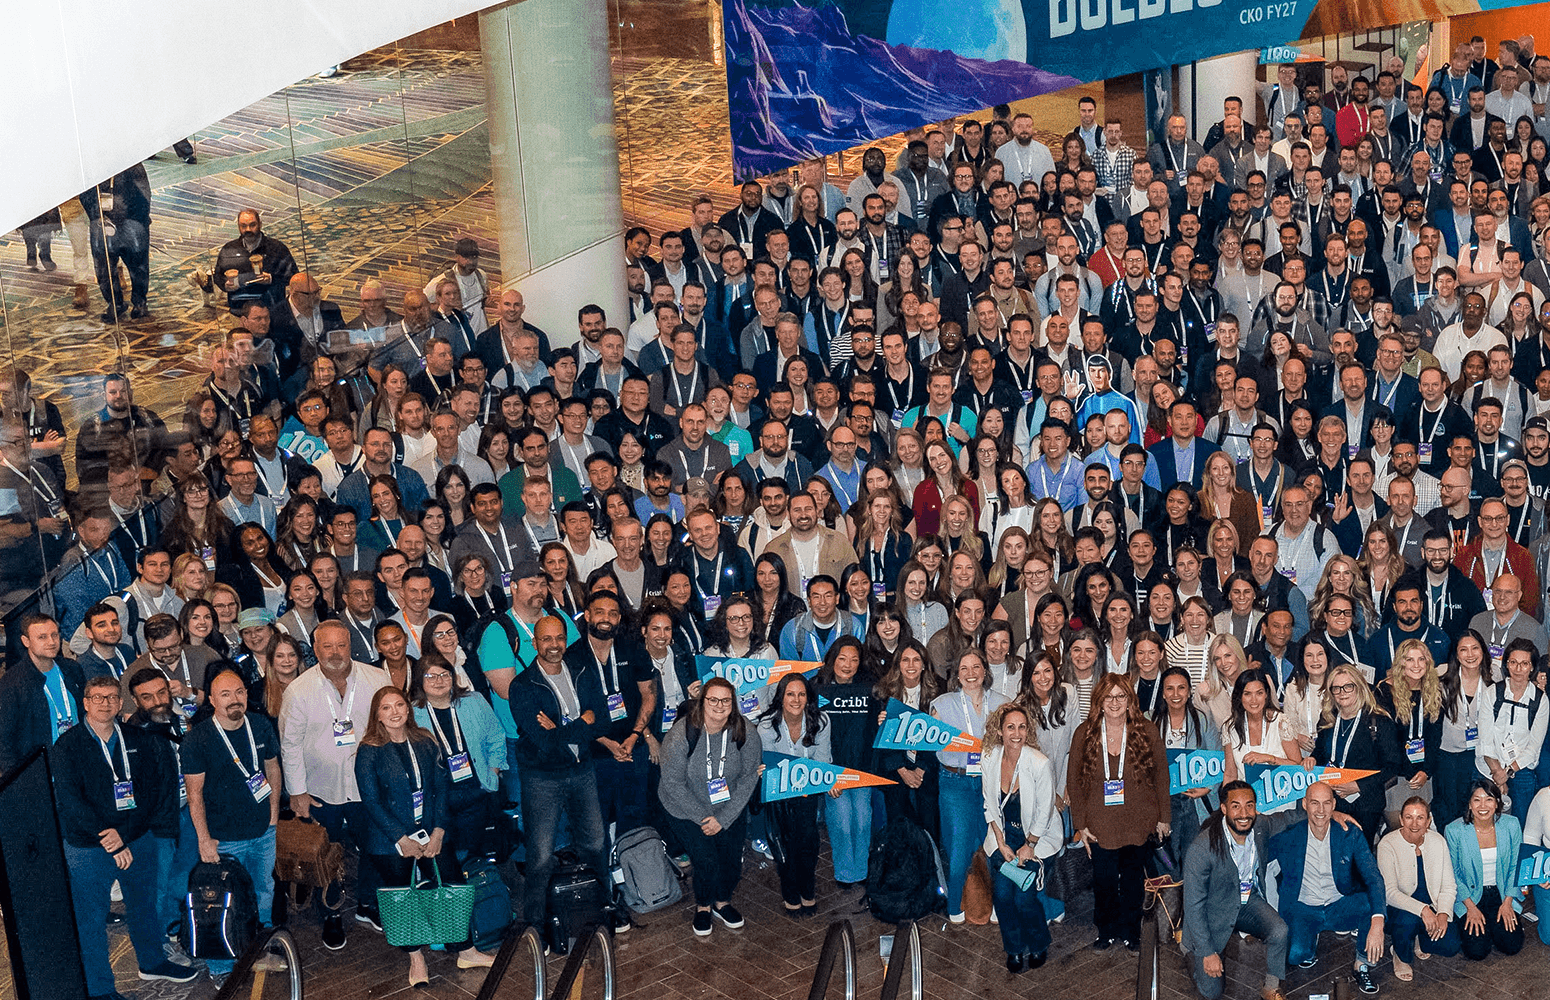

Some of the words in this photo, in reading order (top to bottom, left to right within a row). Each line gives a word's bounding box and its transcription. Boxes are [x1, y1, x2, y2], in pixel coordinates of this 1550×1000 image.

[1239, 7, 1263, 24] CKO
[1266, 1, 1297, 20] FY27
[288, 430, 324, 463] 100
[711, 661, 768, 689] 1000
[833, 696, 868, 707] Cribl
[894, 711, 950, 745] 1000
[778, 758, 834, 793] 1000
[1259, 769, 1316, 803] 1000
